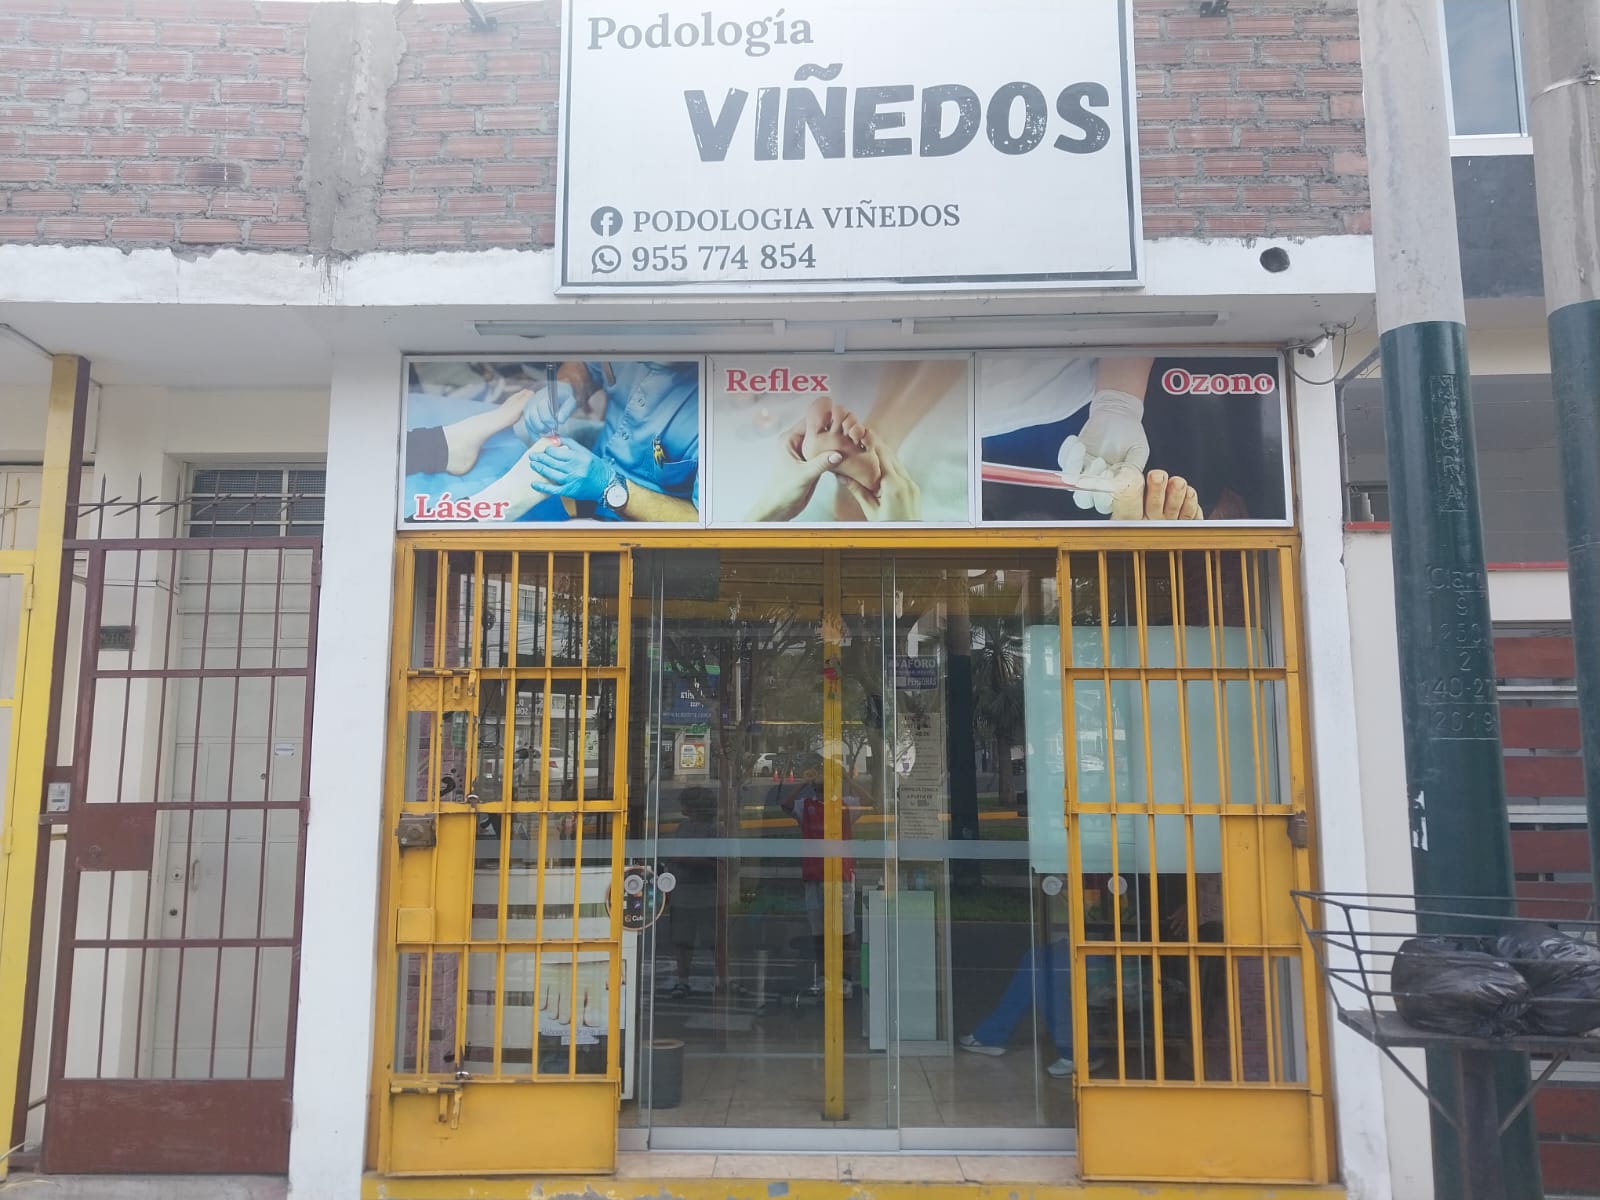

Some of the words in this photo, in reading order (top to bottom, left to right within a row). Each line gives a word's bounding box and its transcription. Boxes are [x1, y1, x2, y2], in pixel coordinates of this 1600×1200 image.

[587, 8, 815, 57] Podología
[684, 63, 1111, 162] VIÑEDOS
[633, 204, 815, 233] PODOLOGIA
[821, 199, 961, 229] VIÑEDOS
[631, 245, 688, 272] 955
[698, 244, 749, 271] 774
[760, 242, 817, 270] 854
[725, 368, 830, 392] Reflex
[1162, 368, 1275, 394] Ozono
[415, 493, 510, 519] Láser
[900, 659, 936, 668] AFORO
